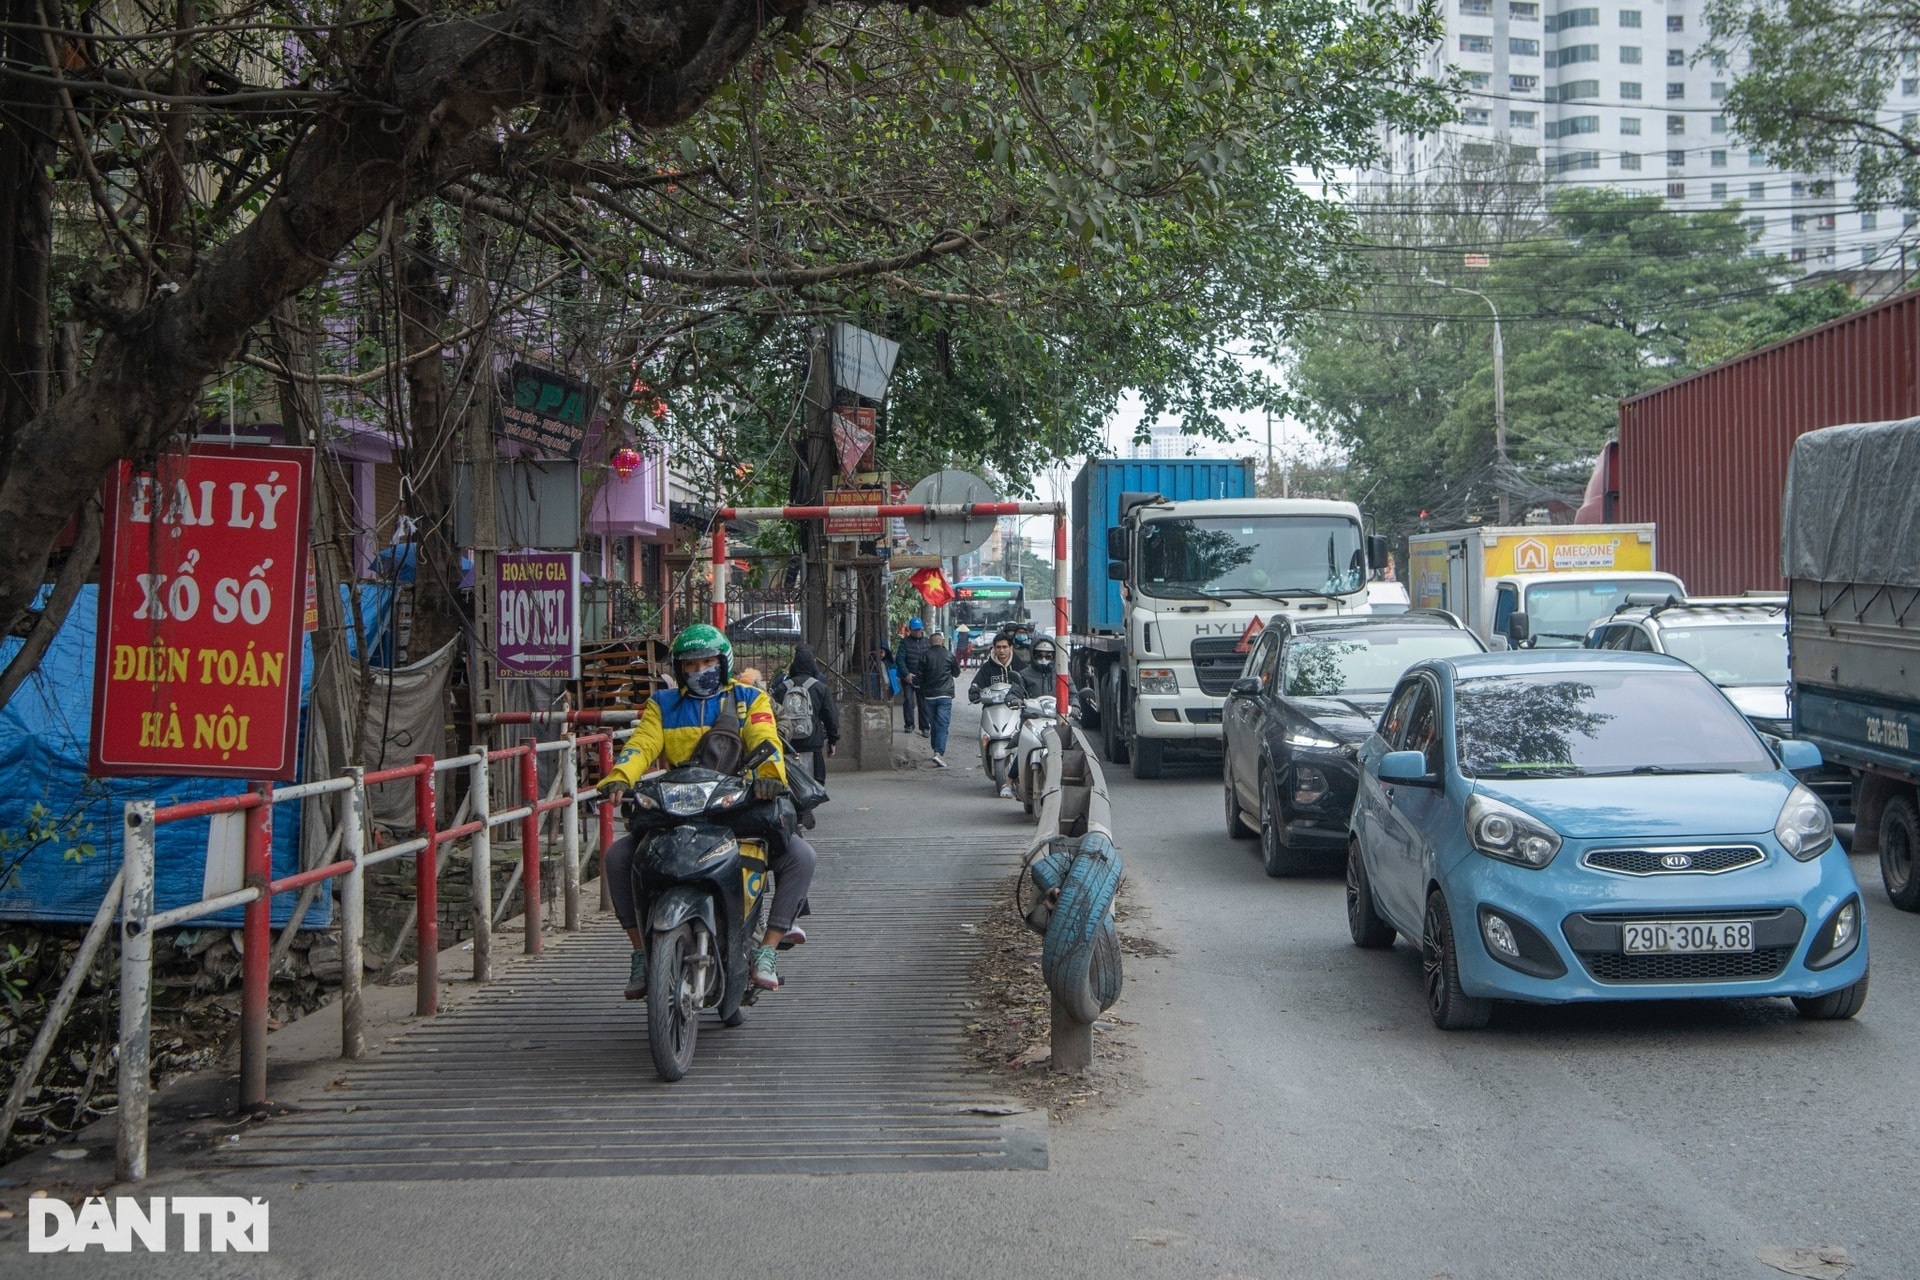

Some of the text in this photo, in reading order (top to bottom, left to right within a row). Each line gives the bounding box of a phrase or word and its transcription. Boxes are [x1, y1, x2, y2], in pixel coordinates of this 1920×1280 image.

[514, 379, 584, 423] SPA
[130, 471, 287, 537] ĐẠI LÝ
[133, 549, 200, 622] XỔ
[213, 558, 273, 625] SỐ
[546, 563, 567, 581] GIA
[500, 589, 569, 646] HOTEL
[1196, 623, 1247, 635] HYU
[113, 637, 283, 692] ĐIỆN TOÁN
[139, 702, 250, 760] HÀ NỘI
[1666, 856, 1688, 866] KIA
[1626, 925, 1751, 951] 29D-304.68
